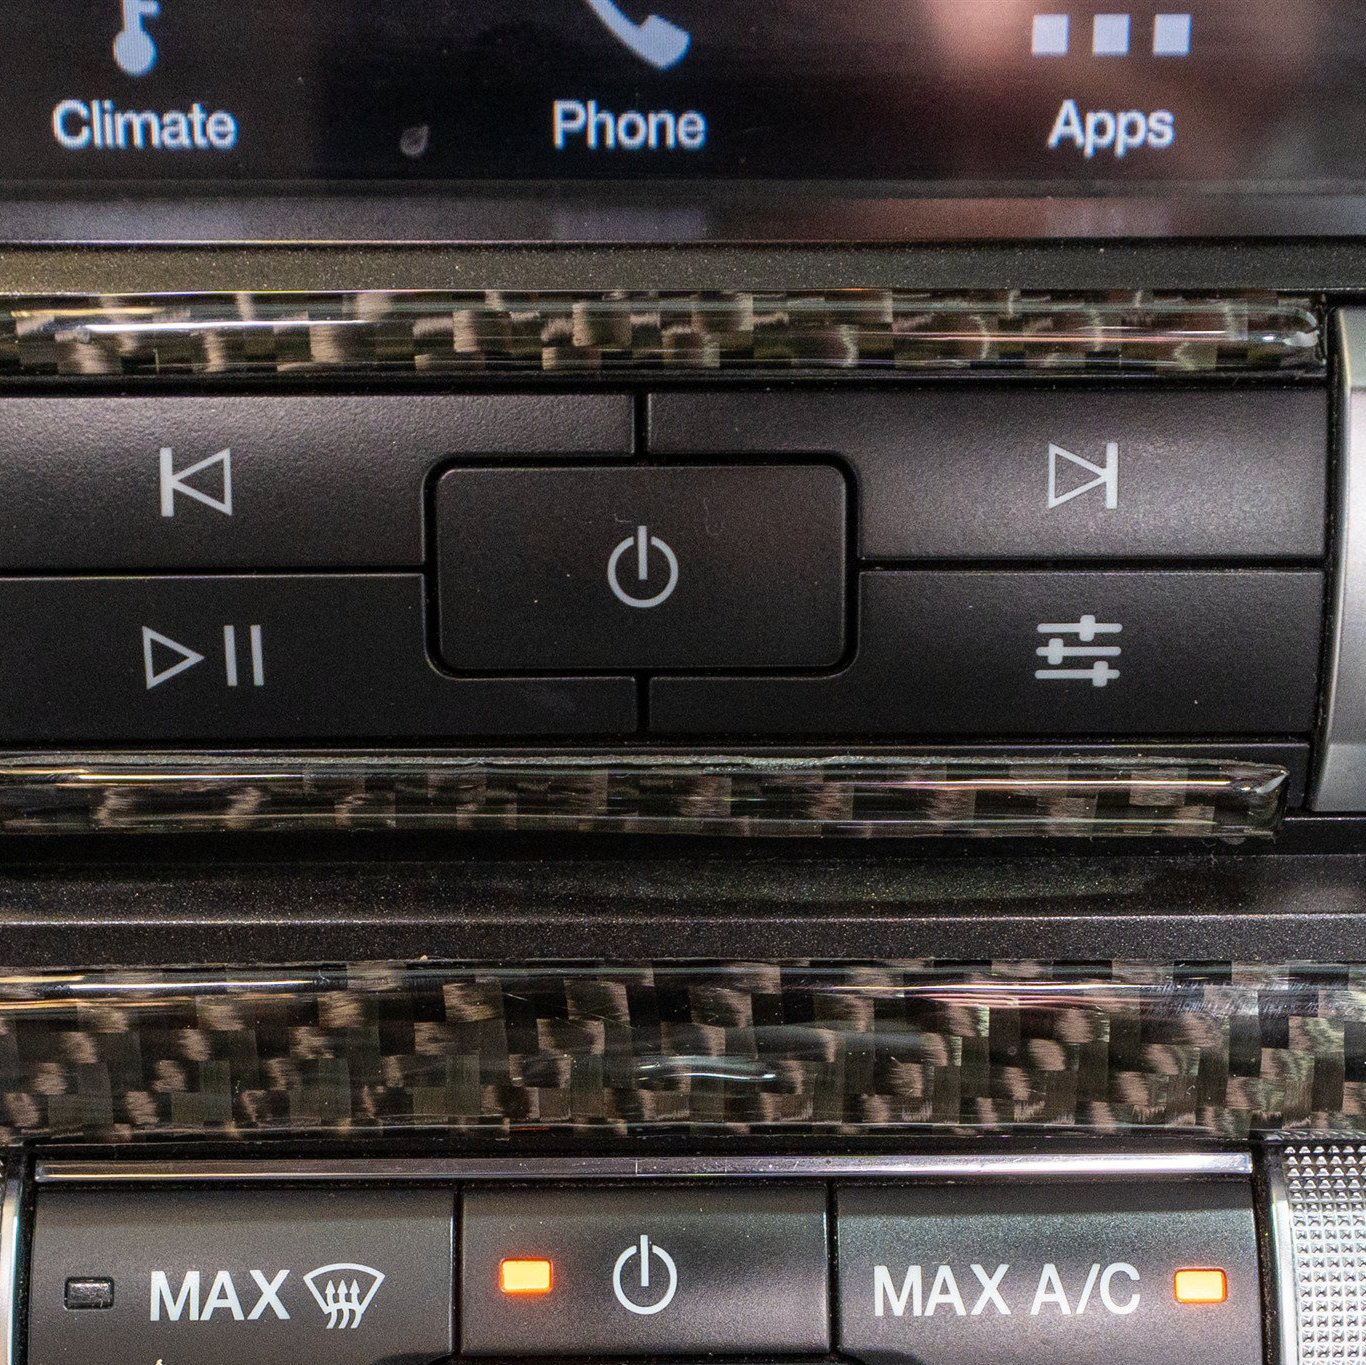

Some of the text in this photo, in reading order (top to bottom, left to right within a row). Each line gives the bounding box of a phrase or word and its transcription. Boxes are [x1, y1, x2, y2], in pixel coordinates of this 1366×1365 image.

[52, 99, 237, 150] Climate
[553, 100, 706, 149] Phone
[1048, 99, 1174, 157] Apps
[149, 1270, 291, 1321] MAX
[873, 1263, 1141, 1317] MAX A/C
